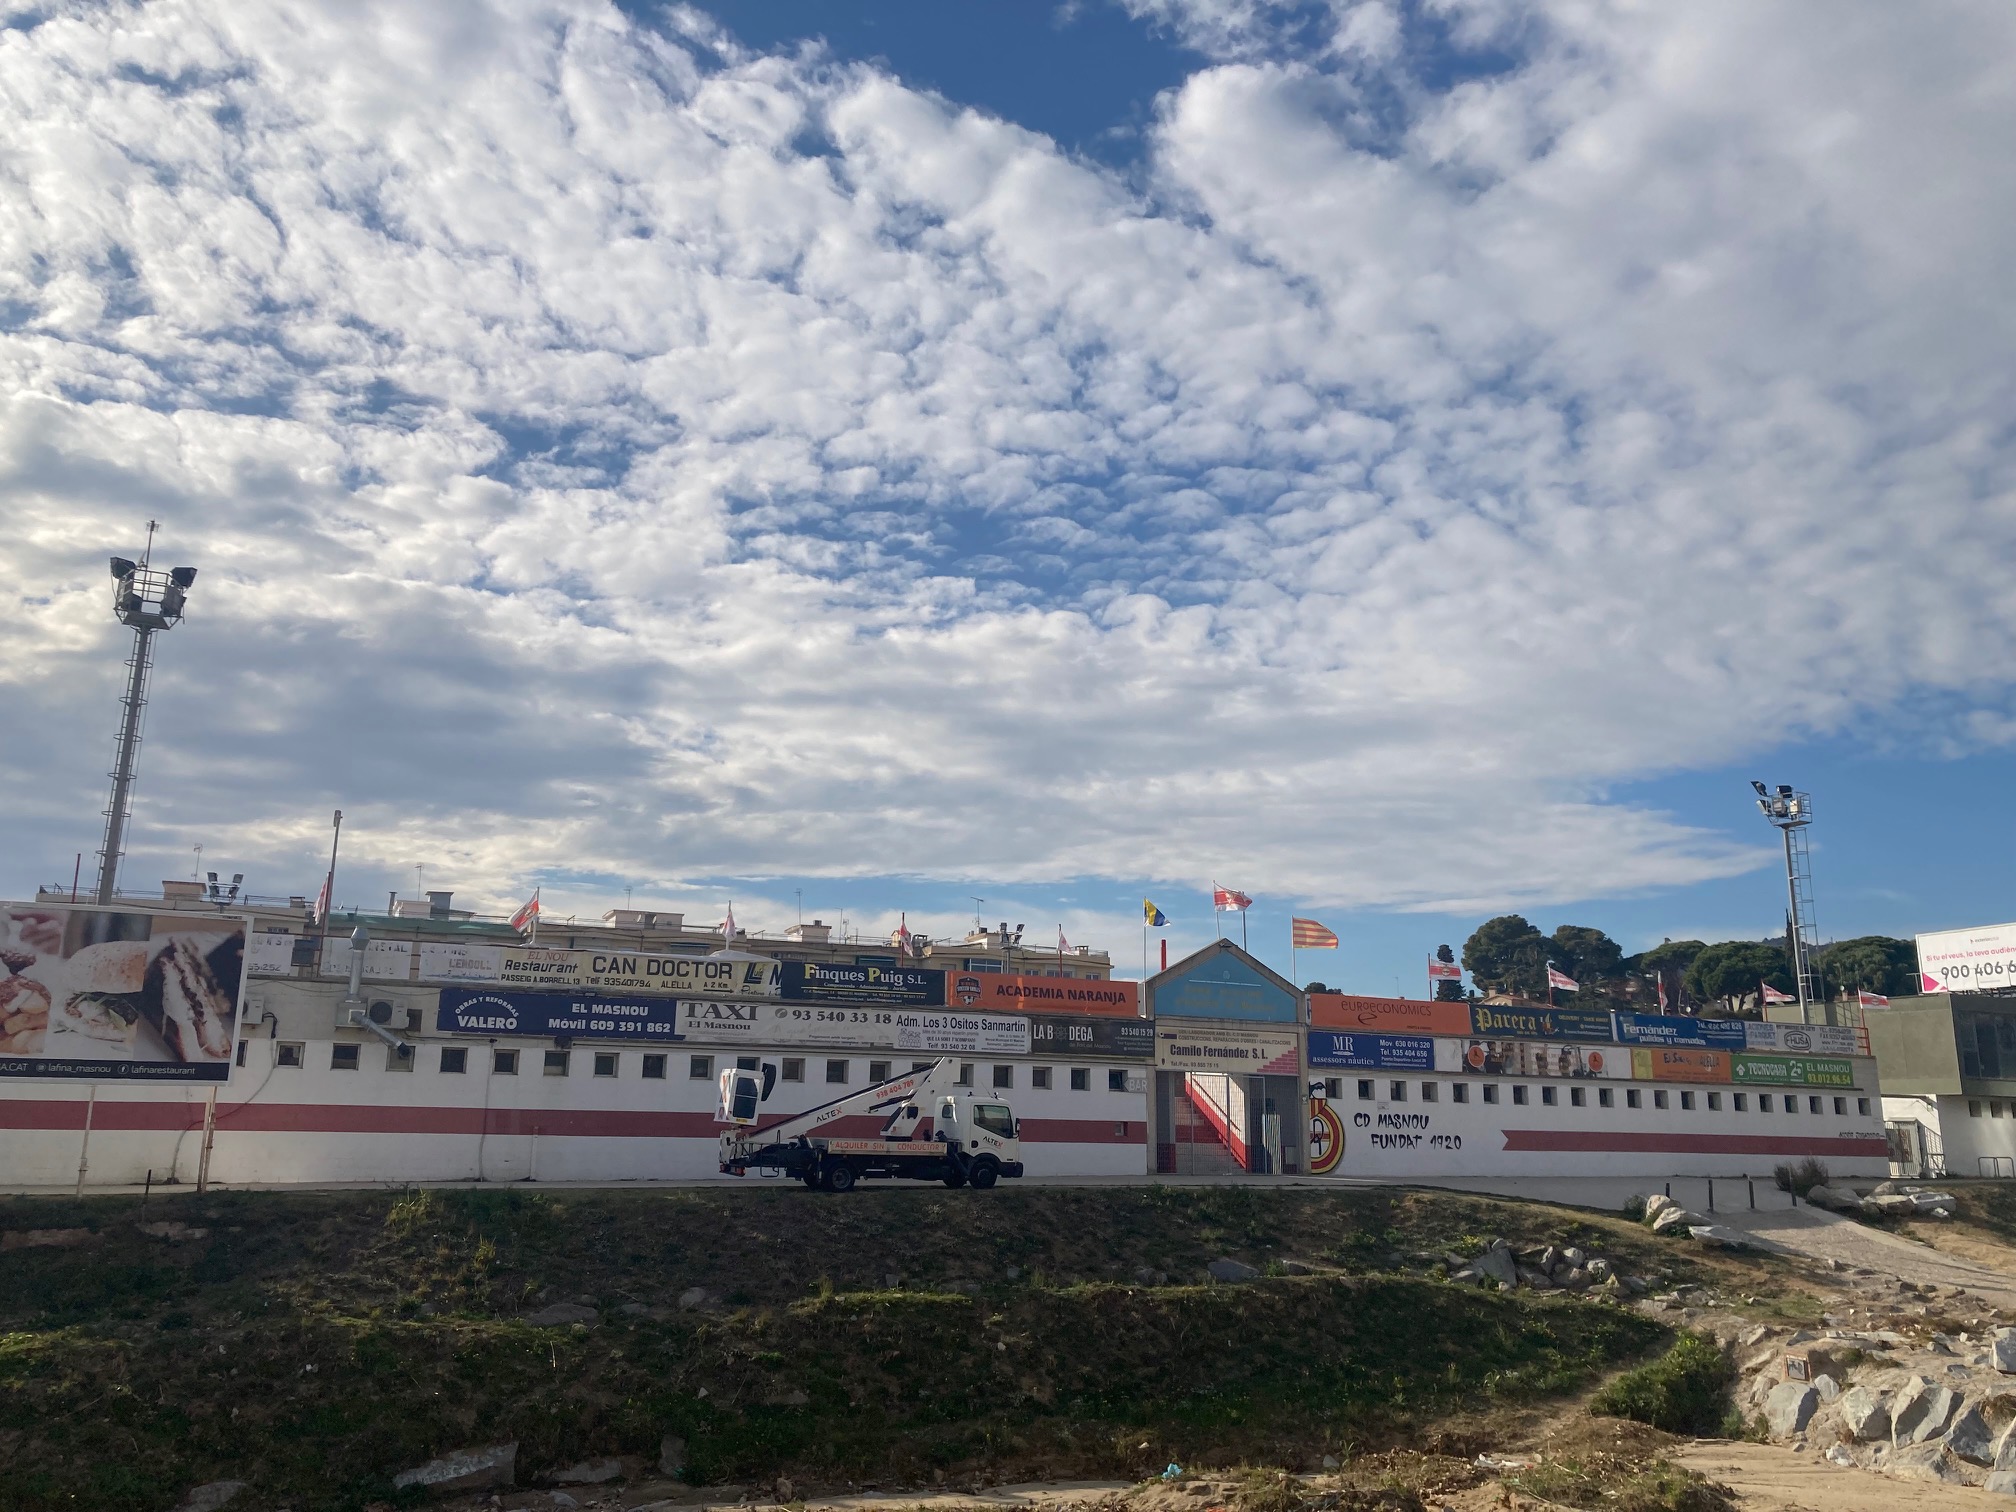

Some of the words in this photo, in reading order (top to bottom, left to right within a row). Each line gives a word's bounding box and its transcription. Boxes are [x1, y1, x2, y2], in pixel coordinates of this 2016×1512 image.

[527, 951, 542, 960] EL
[545, 952, 570, 962] NOU
[1990, 946, 2016, 955] audièn
[505, 959, 578, 974] Restaurant
[592, 956, 636, 975] CAN
[647, 959, 733, 980] DOCTOR
[1941, 965, 1970, 979] 900
[1975, 961, 2003, 976] 406
[501, 974, 531, 983] PASSEIG
[804, 964, 865, 984] Finques
[868, 967, 903, 986] Puig
[908, 974, 927, 984] S.L.
[604, 978, 651, 988] 935401794
[661, 981, 692, 990] ALELLA
[996, 984, 1064, 1000] ACADEMIA
[1068, 990, 1126, 1006] NARANJA
[455, 998, 477, 1014] OBRAS
[486, 996, 519, 1018] REFORMAS
[572, 1003, 588, 1014] EL
[592, 1004, 649, 1016] MASNOU
[682, 1002, 760, 1021] TAXI
[457, 1016, 518, 1030] VALERO
[792, 1009, 811, 1020] 93
[816, 1010, 846, 1022] 540
[850, 1011, 868, 1024] 33
[874, 1013, 892, 1024] 18
[896, 1014, 920, 1028] Adm.
[923, 1016, 940, 1028] Los
[942, 1016, 948, 1028] 3
[950, 1017, 978, 1030] Ositos
[981, 1018, 1026, 1032] Sanmartín
[1476, 1008, 1537, 1031] Parera
[548, 1018, 586, 1030] Móvil
[590, 1020, 614, 1031] 609
[618, 1021, 642, 1032] 391
[647, 1022, 671, 1033] 862
[688, 1020, 700, 1028] El
[704, 1021, 750, 1030] Masnou
[1034, 1024, 1044, 1040] LA
[1121, 1027, 1128, 1036] 93
[1624, 1023, 1678, 1036] Fernández
[1332, 1036, 1354, 1051] MR
[1395, 1040, 1406, 1048] 630
[1170, 1044, 1202, 1056] Camilo
[1204, 1046, 1249, 1059] Fernández
[1417, 1050, 1428, 1058] 656
[1313, 1056, 1346, 1064] assessors
[1348, 1057, 1374, 1065] nàutics
[1807, 1063, 1815, 1071] EL
[1817, 1064, 1850, 1073] MASNOU
[0, 1062, 28, 1072] A.CAT
[49, 1064, 111, 1073] lafina_masnou
[132, 1065, 195, 1075] lafinarestaurant
[876, 1091, 888, 1099] 938
[889, 1086, 902, 1094] 404
[903, 1080, 914, 1088] 789
[1130, 1080, 1147, 1091] BAR
[816, 1106, 842, 1123] ALTEX
[1354, 1112, 1370, 1127] CD
[1378, 1113, 1430, 1130] MASNOU
[983, 1136, 1003, 1149] ALTEX
[1371, 1134, 1422, 1150] FUNDAT
[1430, 1135, 1462, 1150] 1920
